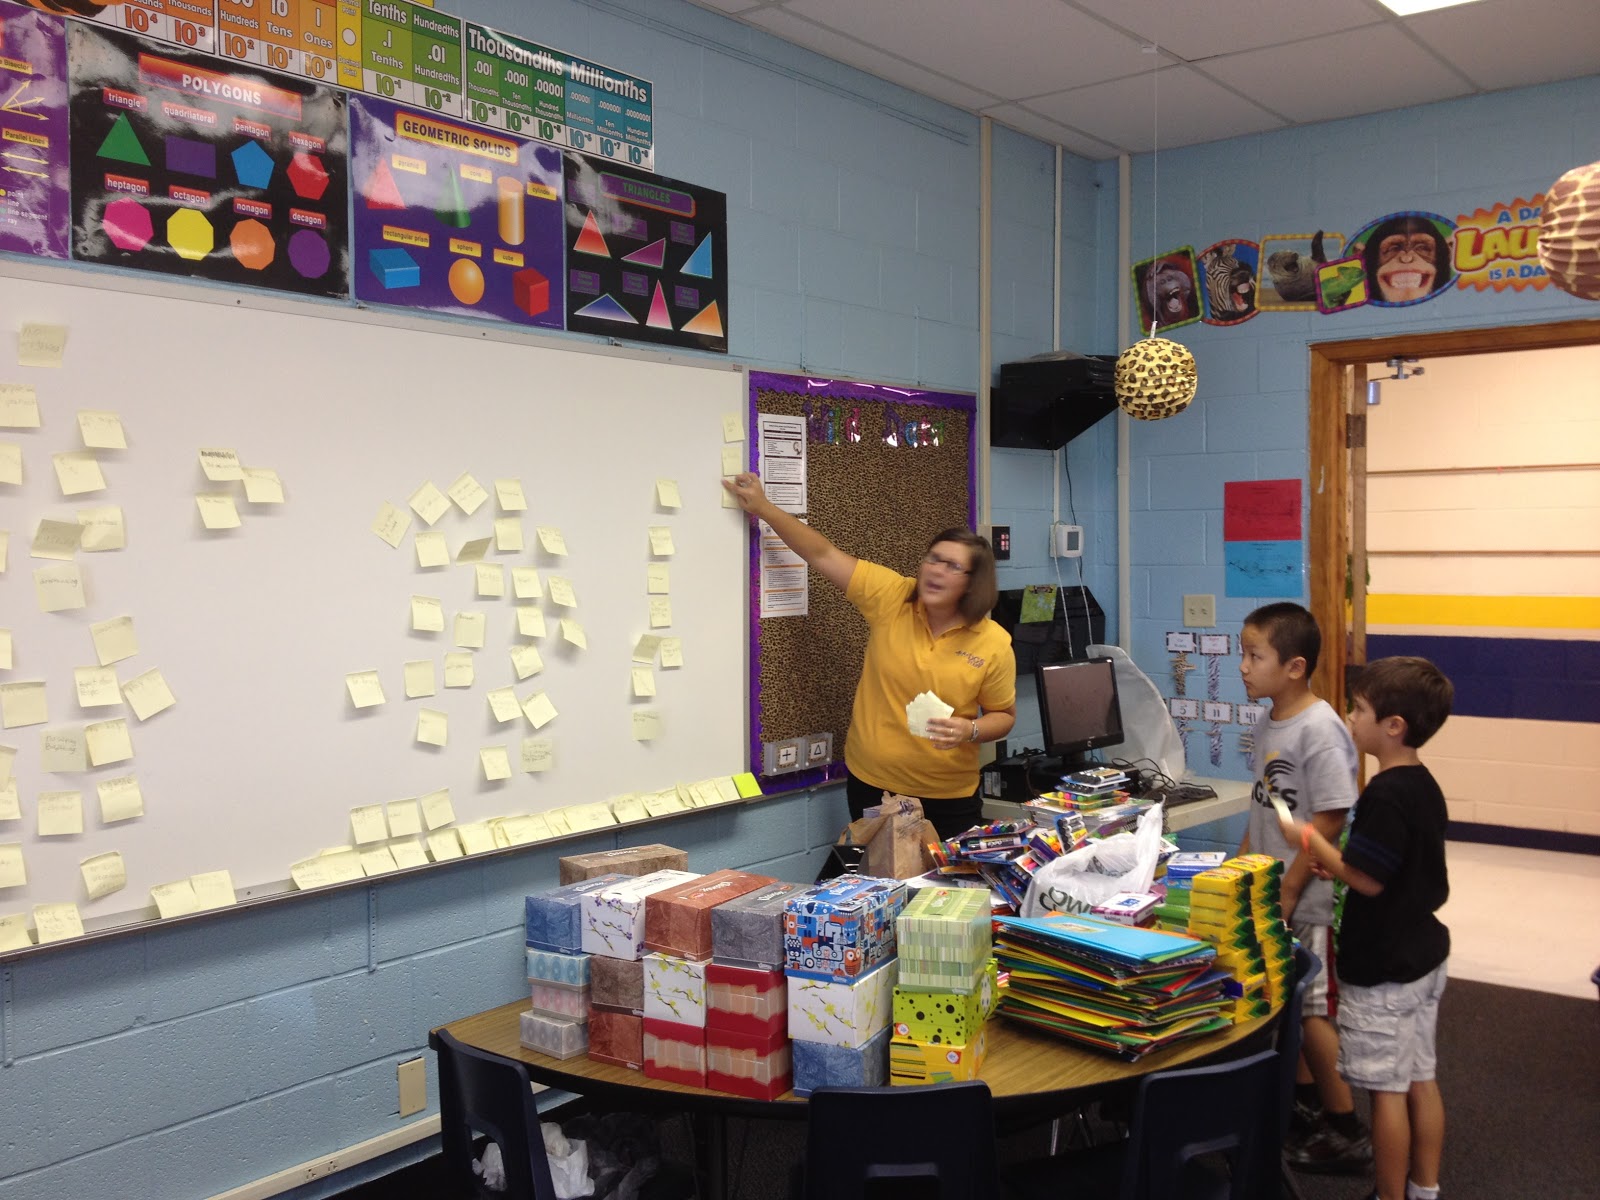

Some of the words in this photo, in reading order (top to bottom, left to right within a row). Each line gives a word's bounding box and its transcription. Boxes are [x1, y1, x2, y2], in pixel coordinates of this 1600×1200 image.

[220, 10, 259, 29] Hundreds
[369, 0, 407, 24] Tenths
[266, 21, 293, 38] Tens
[413, 14, 459, 38] Hundredths
[304, 32, 333, 49] Ones
[371, 51, 403, 70] Tenths
[469, 28, 563, 76] Thousandths
[571, 61, 647, 103] Millionths
[414, 64, 459, 85] Hundredths
[182, 74, 262, 105] POLYGONS
[468, 82, 499, 97] Thousandths
[108, 93, 141, 109] triangle
[164, 105, 215, 124] quadrilateral
[5, 131, 28, 141] Parallel
[235, 122, 270, 138] pentagon
[292, 135, 322, 150] hexagon
[403, 120, 470, 147] GEOMETRIC
[473, 138, 511, 158] SOLIDS
[107, 177, 147, 194] heptagon
[623, 183, 671, 203] TRIANGLES
[173, 191, 206, 204] octagon
[236, 202, 269, 217] nonagon
[1497, 211, 1512, 224] A
[1519, 207, 1541, 221] DA
[292, 212, 322, 226] decagon
[384, 230, 413, 241] rectangular
[414, 235, 429, 244] prism
[456, 243, 473, 252] sphere
[1454, 225, 1540, 272] LAU
[502, 254, 514, 262] cube
[1489, 269, 1502, 280] IS
[1506, 268, 1516, 278] A
[1519, 265, 1546, 278] DA
